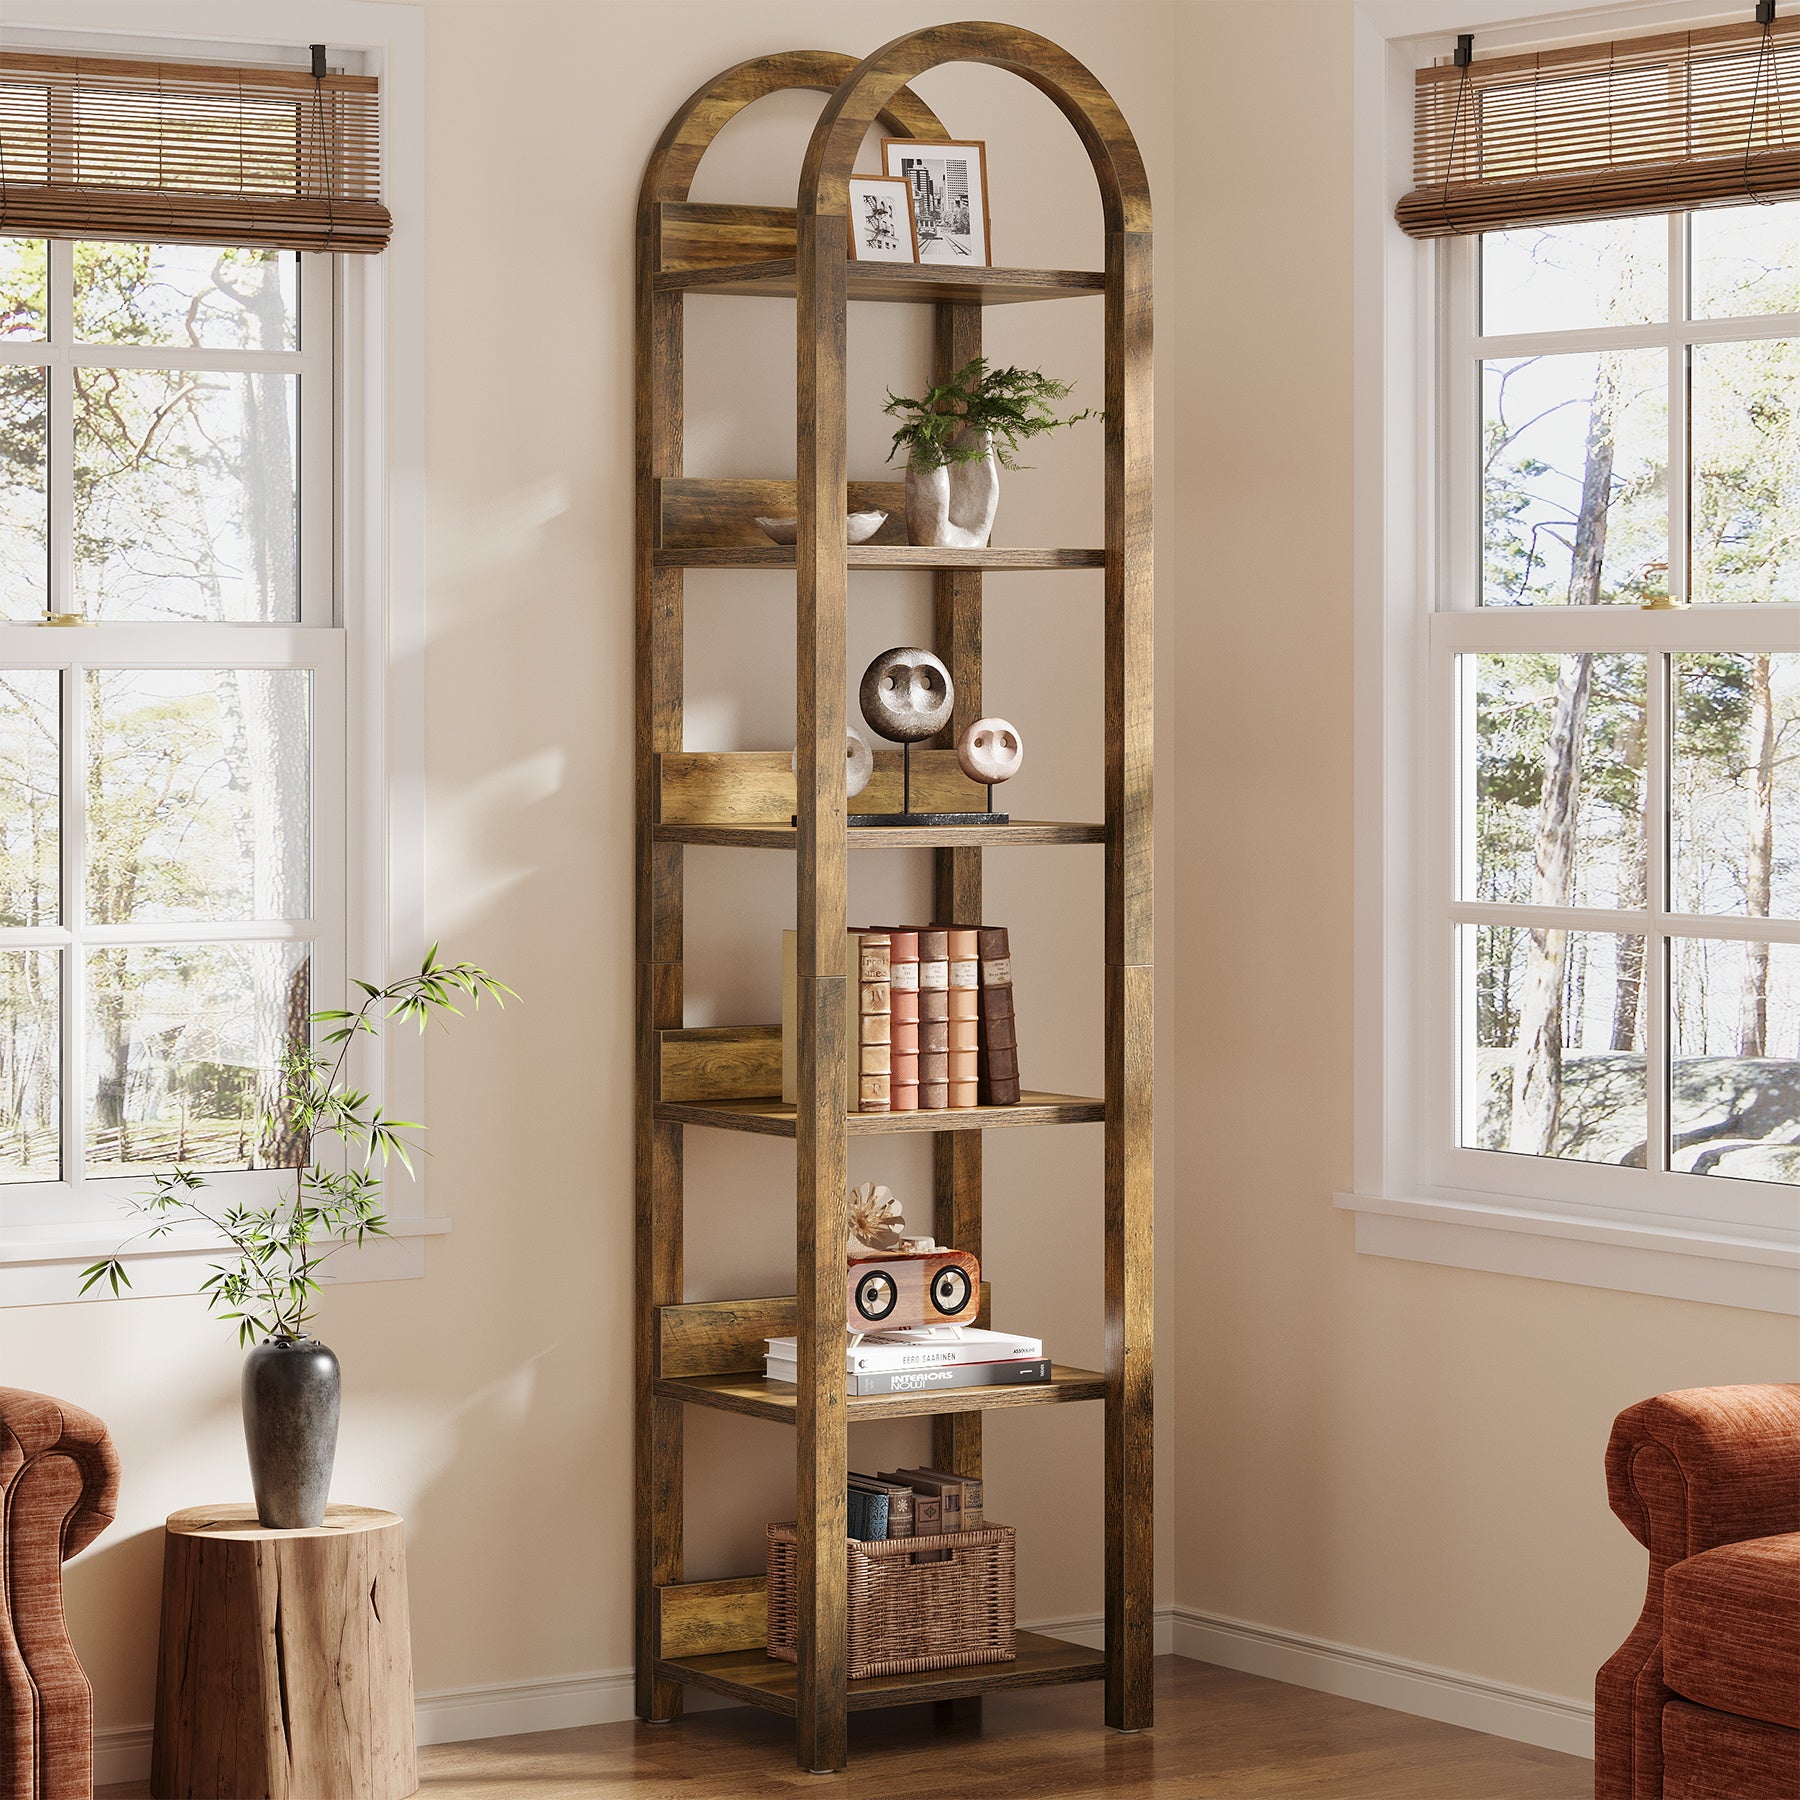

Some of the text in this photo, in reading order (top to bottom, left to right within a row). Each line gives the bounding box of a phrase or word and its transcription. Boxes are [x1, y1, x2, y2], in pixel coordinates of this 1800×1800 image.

[903, 1352, 956, 1364] EERO SAARINEN
[890, 1371, 953, 1383] INTERIORS
[890, 1381, 926, 1391] NOW!
